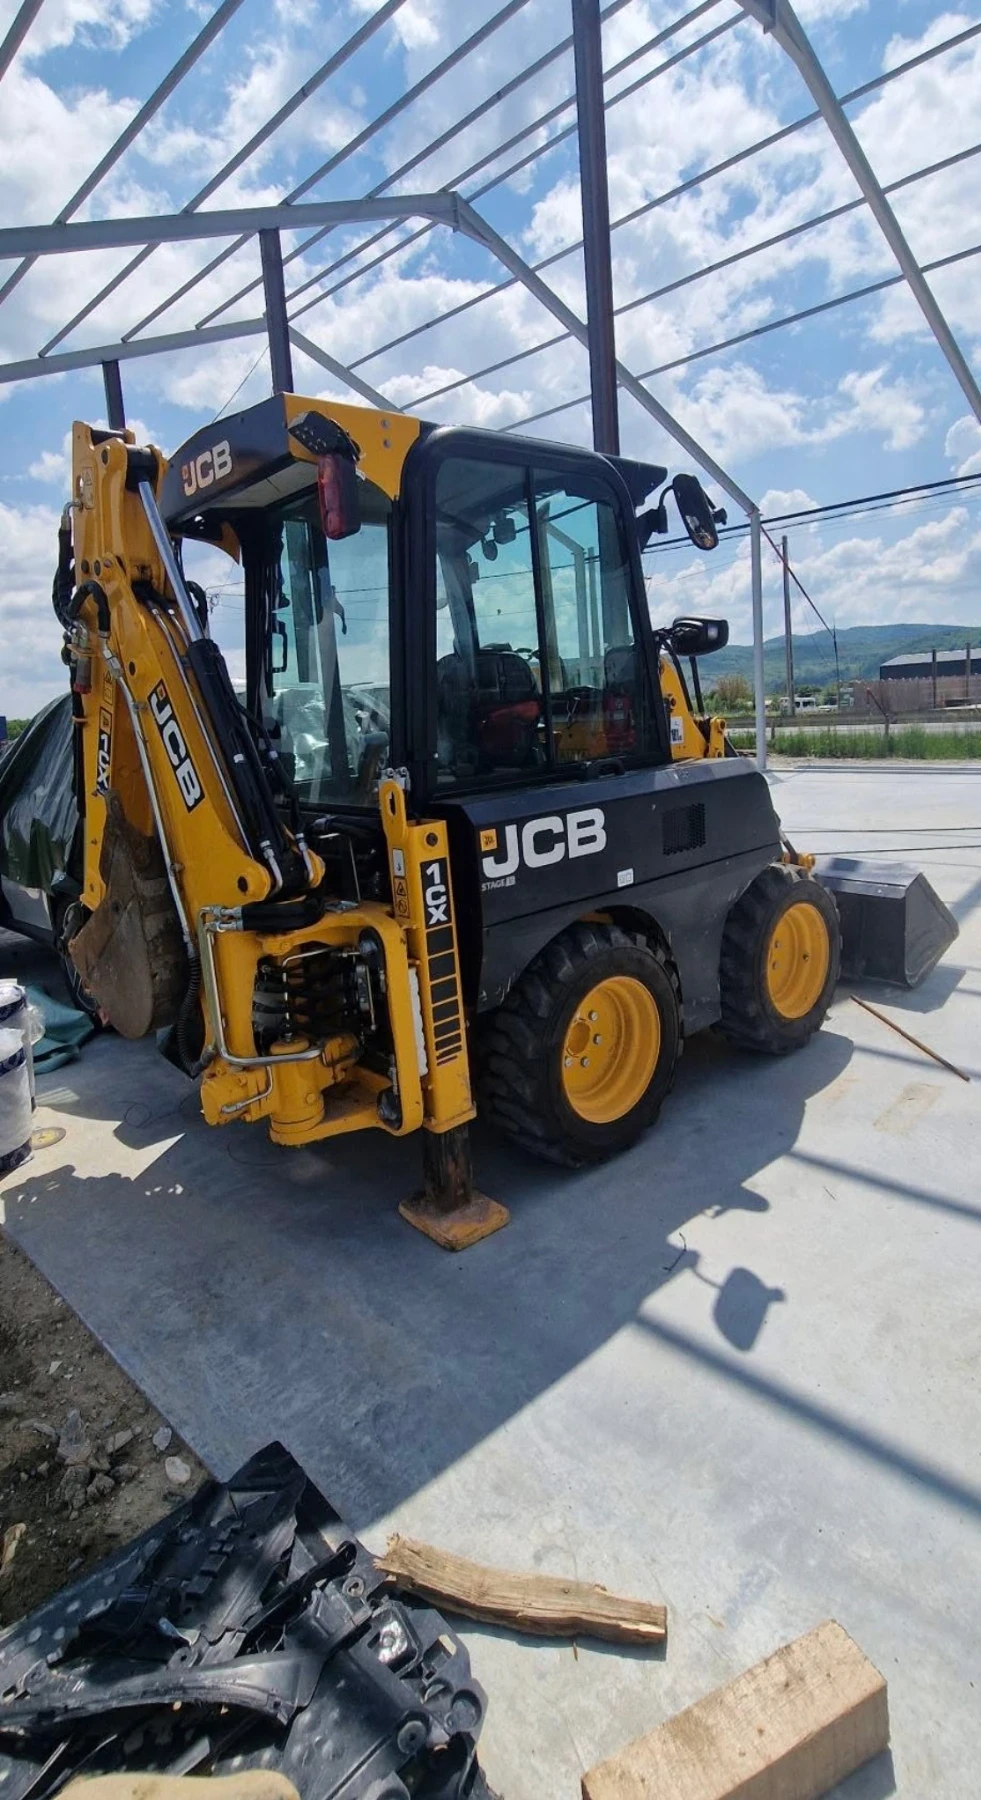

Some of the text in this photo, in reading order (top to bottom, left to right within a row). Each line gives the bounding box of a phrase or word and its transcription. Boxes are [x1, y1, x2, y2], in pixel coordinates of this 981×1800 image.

[183, 440, 232, 496] JCB
[151, 688, 201, 807] JCB
[481, 808, 607, 878] JCB
[425, 862, 448, 925] 1CX
[481, 878, 505, 891] STAGE
